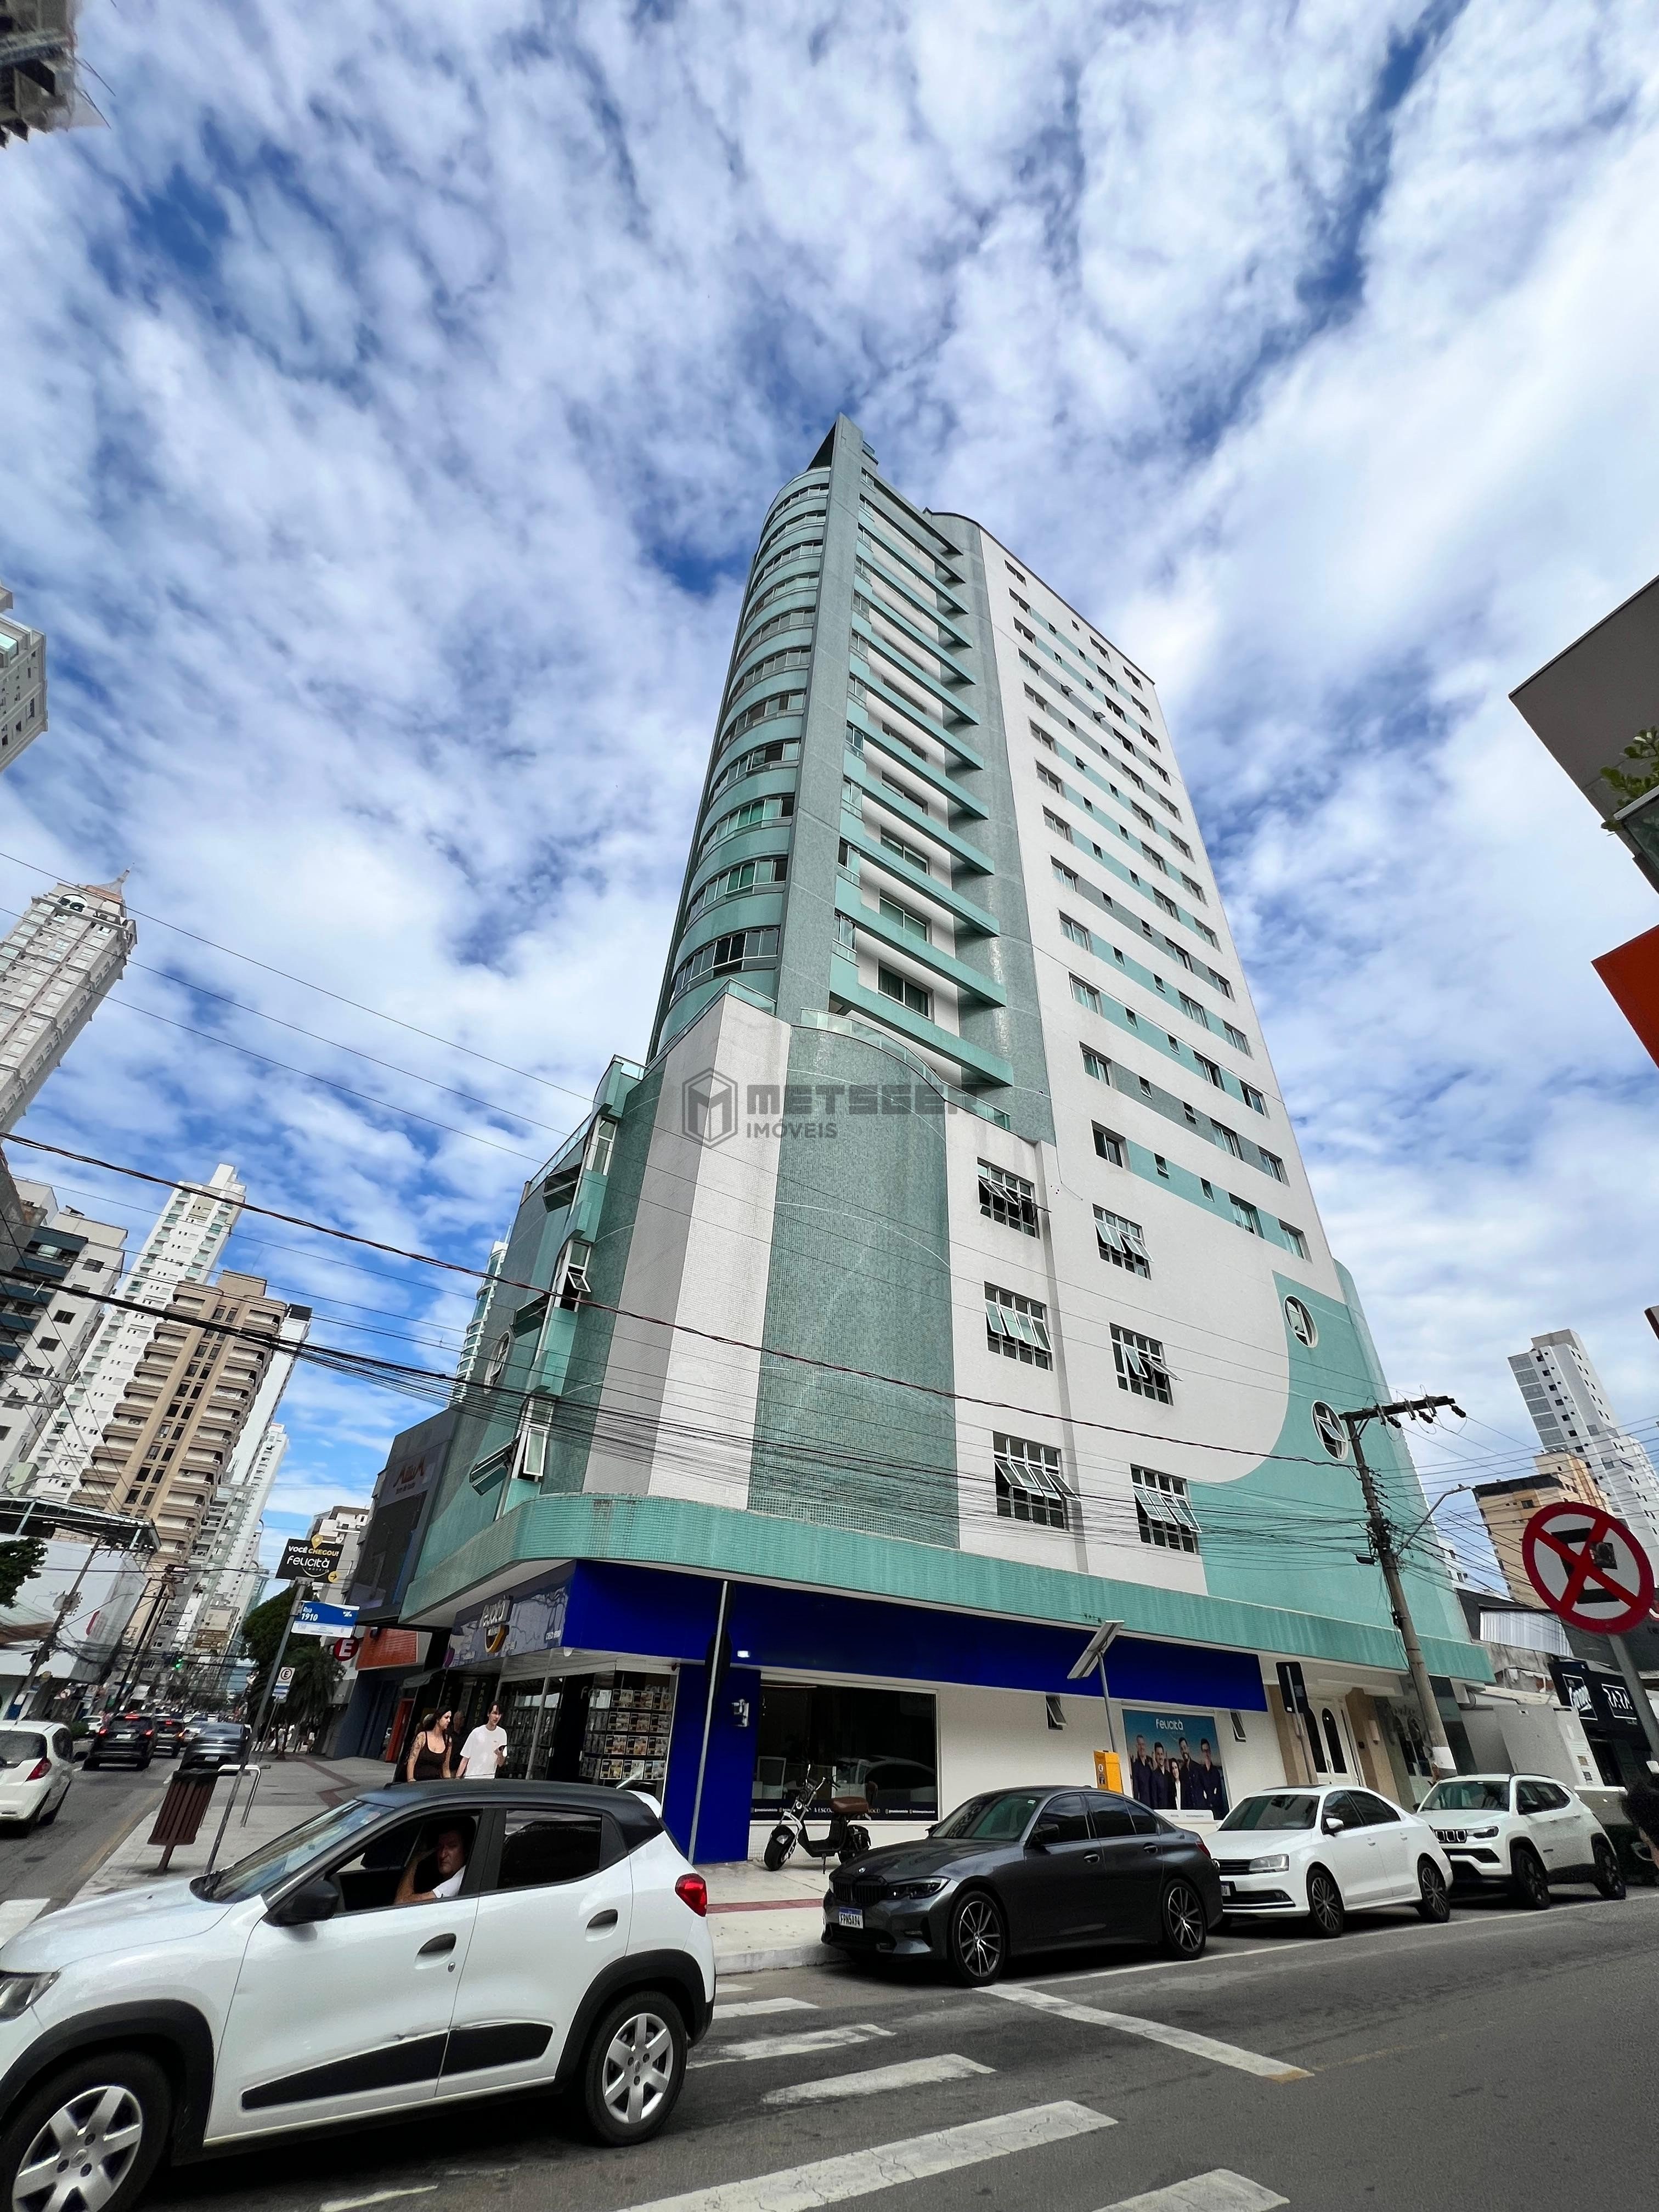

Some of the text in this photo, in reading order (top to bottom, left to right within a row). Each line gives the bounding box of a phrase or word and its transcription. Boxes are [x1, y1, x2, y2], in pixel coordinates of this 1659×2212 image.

[288, 1545, 339, 1557] VOCÊ CHEGOU!
[301, 1613, 318, 1621] 1910
[338, 1639, 354, 1657] E
